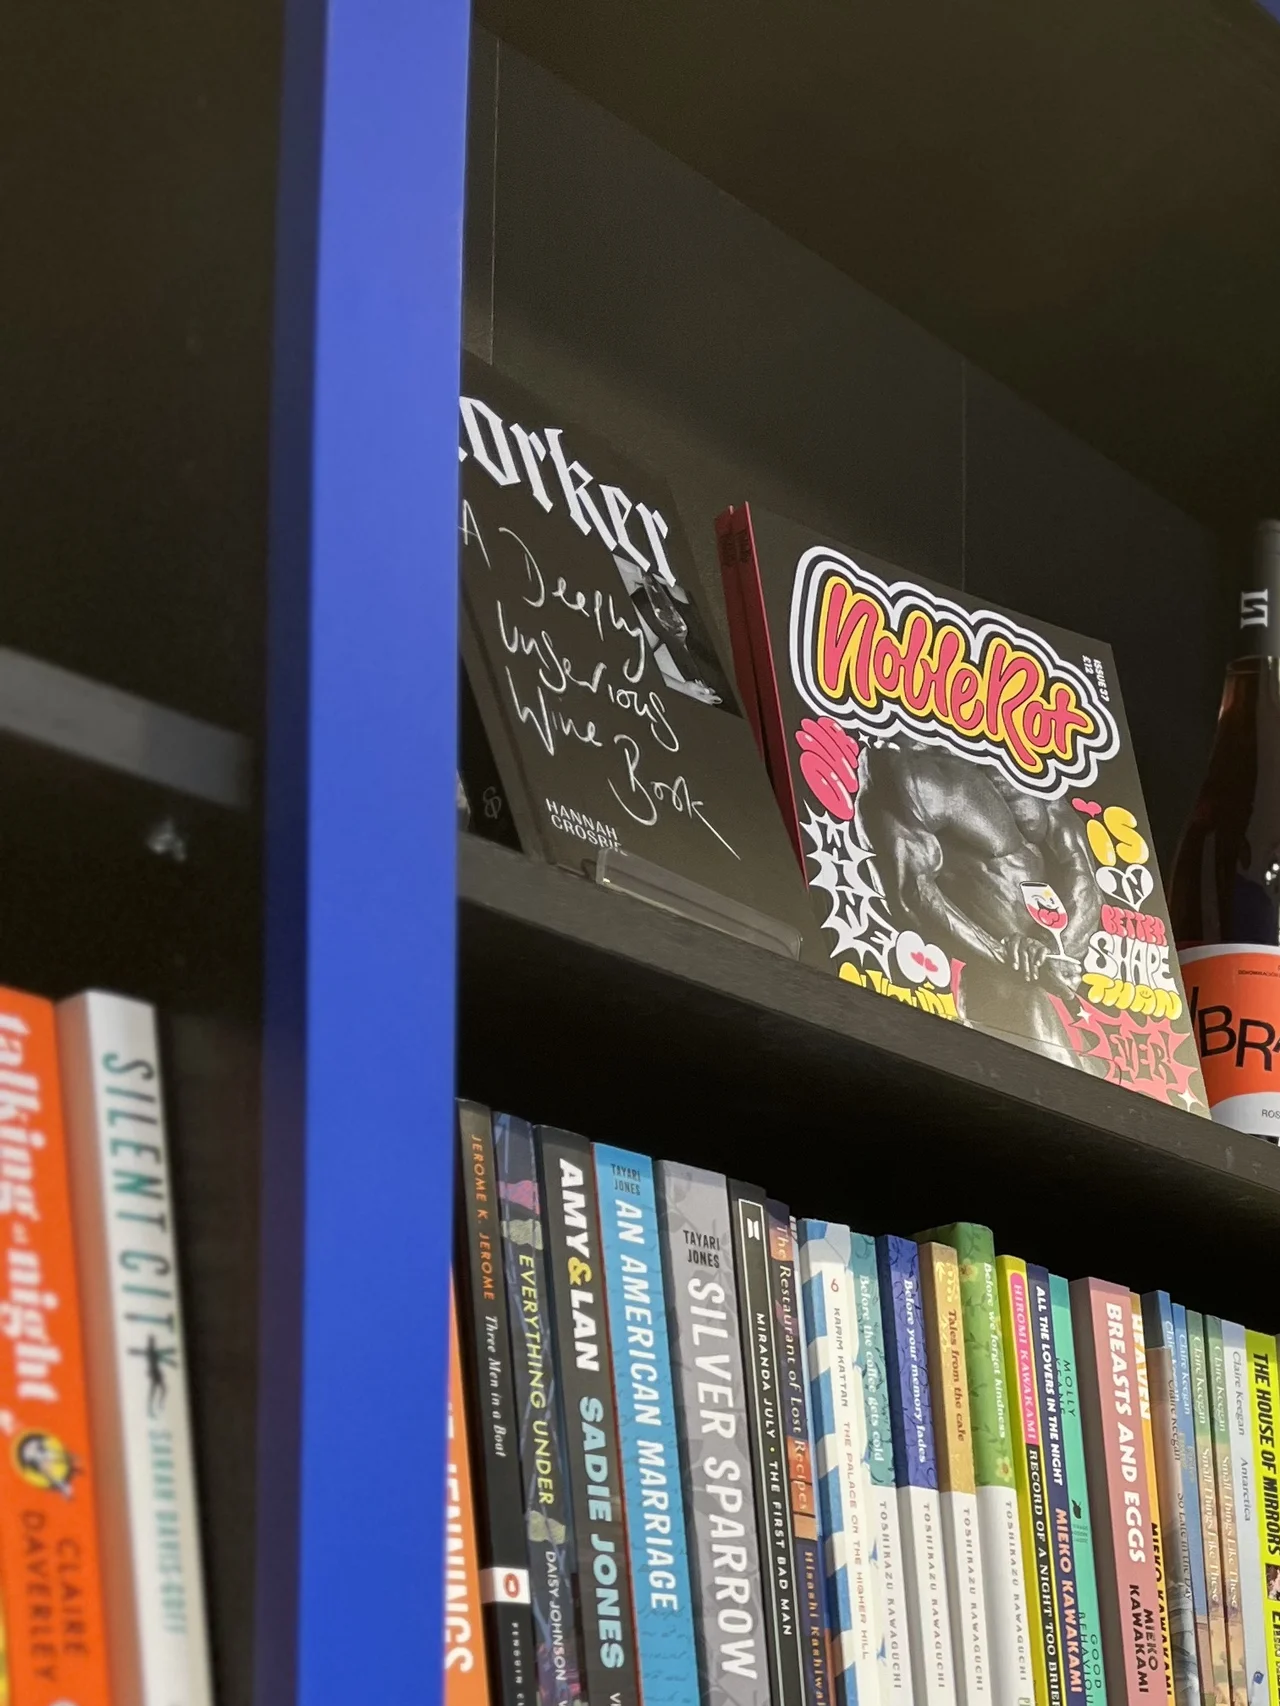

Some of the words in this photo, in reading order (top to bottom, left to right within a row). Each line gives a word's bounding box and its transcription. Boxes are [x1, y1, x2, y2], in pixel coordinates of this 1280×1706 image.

[459, 396, 677, 587] orker
[1094, 659, 1107, 687] ISSUE
[506, 666, 602, 755] Wine
[546, 799, 617, 841] HANNAH
[1101, 904, 1167, 946] BETTER
[1084, 931, 1179, 995] SHAPE
[1082, 973, 1182, 1020] THAN
[104, 1053, 167, 1234] SILENT
[472, 1135, 485, 1202] JEROME
[480, 1234, 495, 1299] JEROME
[616, 1200, 645, 1245] AN
[485, 1315, 499, 1353] Three
[519, 1255, 546, 1410] EVERYTHING
[904, 1280, 917, 1327] Before
[620, 1254, 662, 1424] AMERICAN
[688, 1278, 737, 1440] SILVER
[756, 1312, 770, 1392] MIRANDA
[906, 1328, 919, 1361] your
[1105, 1302, 1132, 1418] BREASTS
[1253, 1353, 1270, 1387] THE
[489, 1356, 501, 1387] Men
[909, 1365, 924, 1422] memory
[493, 1422, 506, 1457] Boat
[763, 1399, 775, 1440] JULY
[916, 1424, 927, 1464] fades
[1256, 1387, 1275, 1449] HOUSE
[532, 1420, 553, 1506] UNDER
[580, 1397, 612, 1522] SADIE
[769, 1462, 780, 1493] THE
[1118, 1422, 1138, 1482] AND
[1261, 1450, 1276, 1474] OF
[637, 1438, 678, 1609] MARRIAGE
[772, 1500, 785, 1548] FIRST
[1124, 1491, 1146, 1564] EGGS
[24, 1511, 55, 1683] DAVERLEY
[57, 1537, 86, 1656] CLAIRE
[704, 1457, 757, 1679] SPARROW
[777, 1555, 788, 1591] BAD
[590, 1533, 625, 1668] JONES
[780, 1597, 792, 1637] MAN
[1129, 1584, 1149, 1694] KAWAKAMI
[1144, 1609, 1158, 1671] MIEKO
